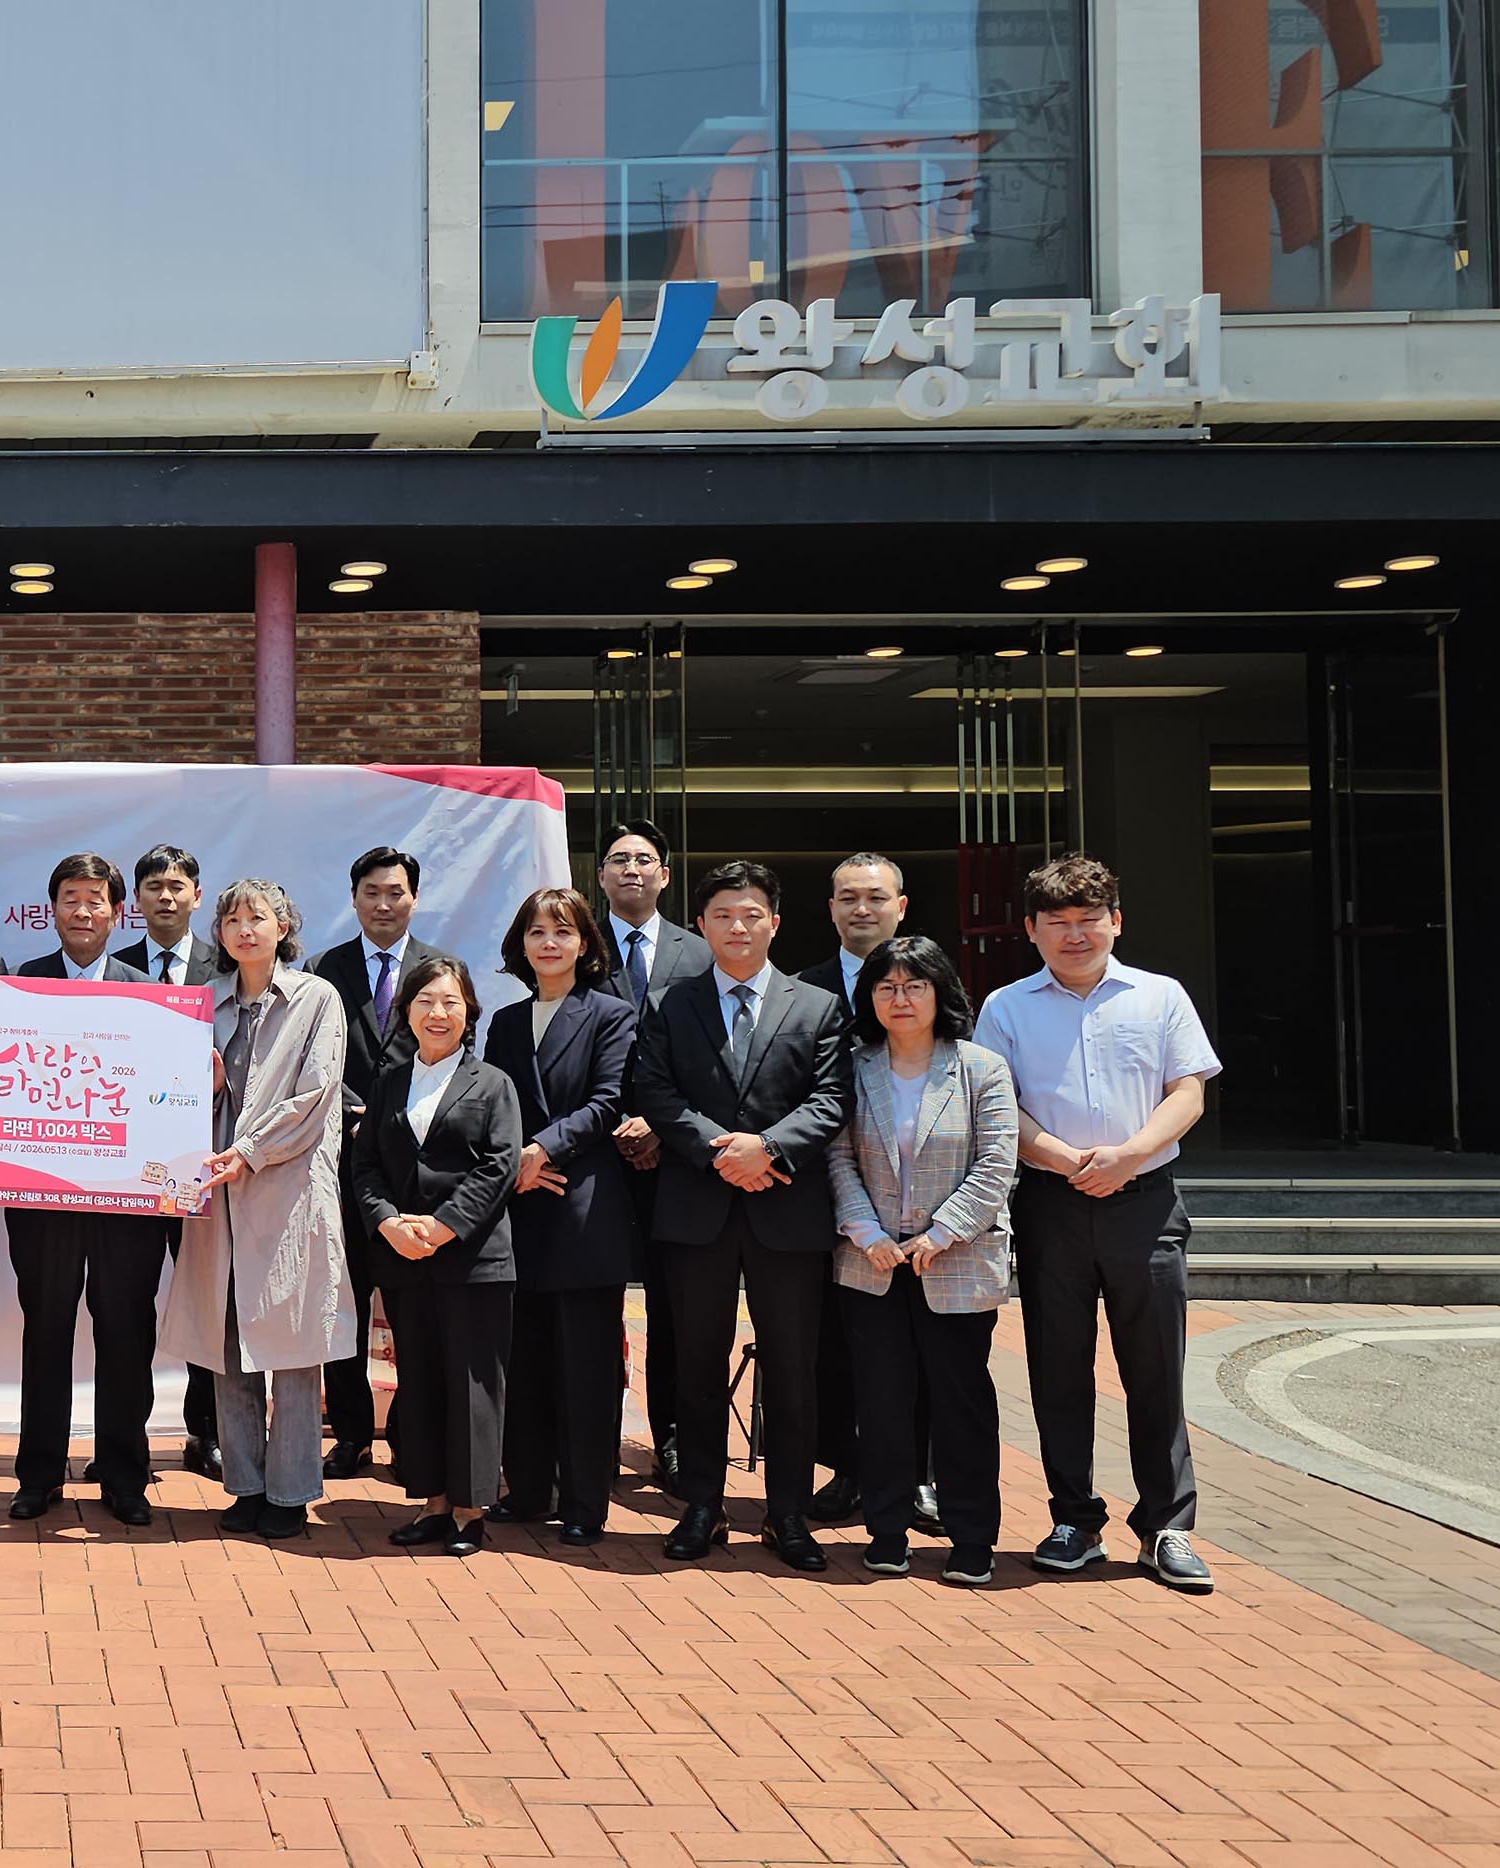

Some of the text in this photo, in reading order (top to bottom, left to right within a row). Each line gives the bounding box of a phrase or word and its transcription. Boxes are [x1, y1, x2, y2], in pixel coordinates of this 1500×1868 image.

[726, 293, 1221, 423] 왕성교회
[4, 904, 56, 930] 사랑
[111, 1066, 136, 1076] 2026
[3, 1120, 112, 1141] 라면 1,004 박스
[20, 1144, 68, 1156] 2026.05.13
[93, 1148, 127, 1158] 왕성교회
[43, 1193, 61, 1204] 308,
[61, 1194, 92, 1206] 왕성교회
